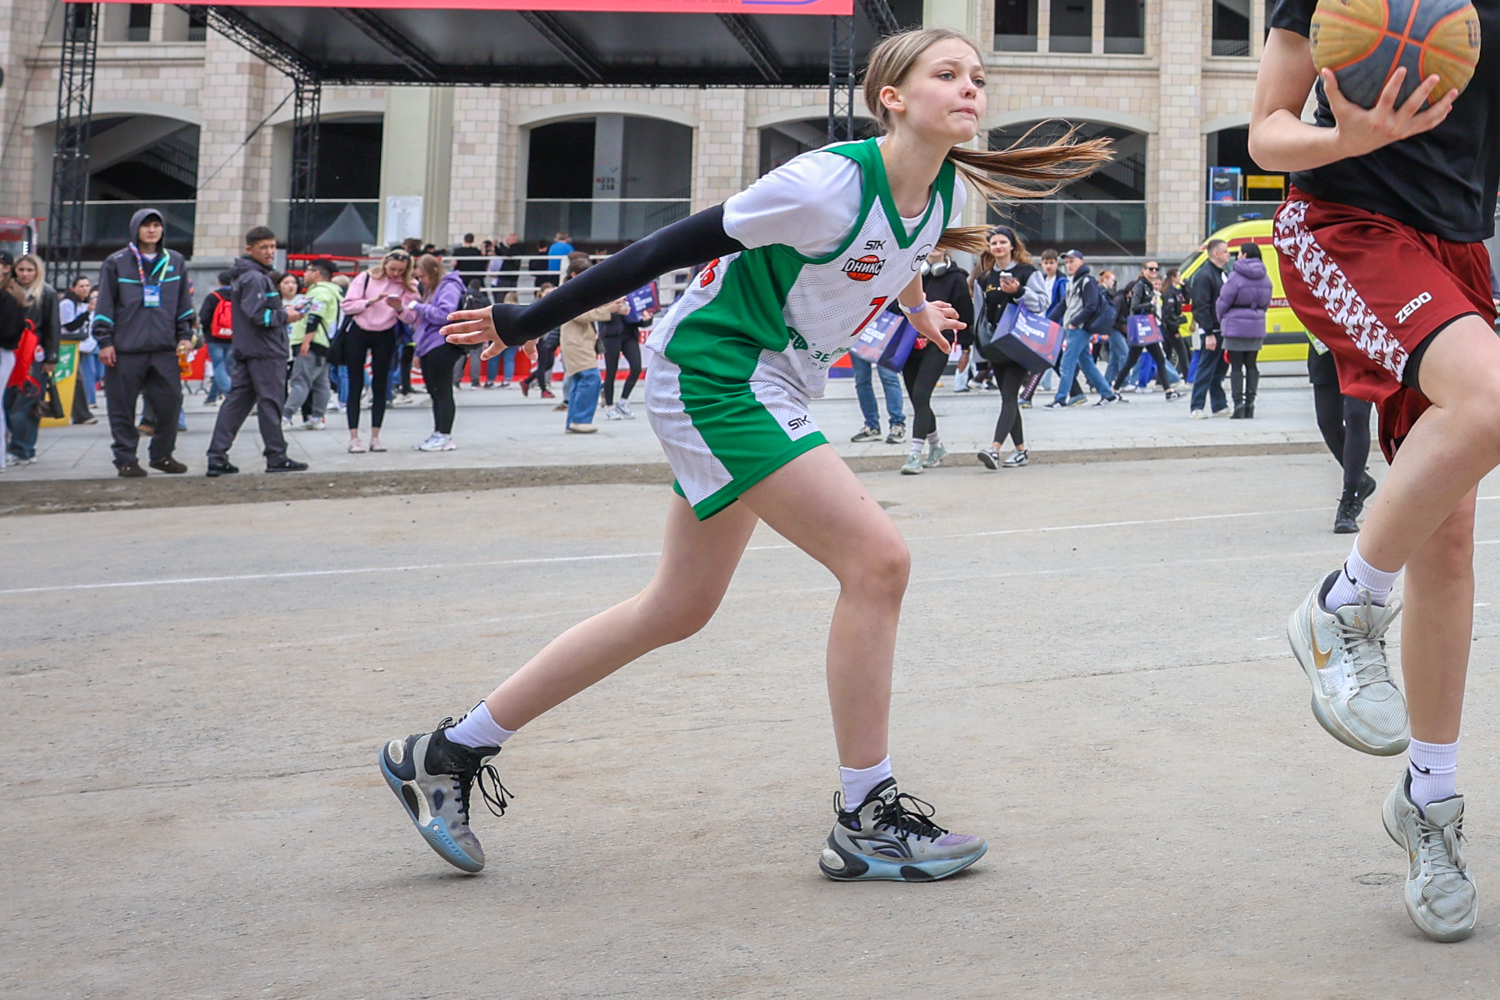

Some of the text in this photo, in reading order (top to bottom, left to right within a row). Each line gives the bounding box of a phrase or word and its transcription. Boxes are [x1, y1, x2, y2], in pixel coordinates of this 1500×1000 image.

[863, 240, 887, 251] STK
[845, 261, 883, 274] ОНИКС
[1394, 291, 1433, 324] ZEDO
[851, 296, 888, 338] 7
[788, 414, 811, 431] STK
